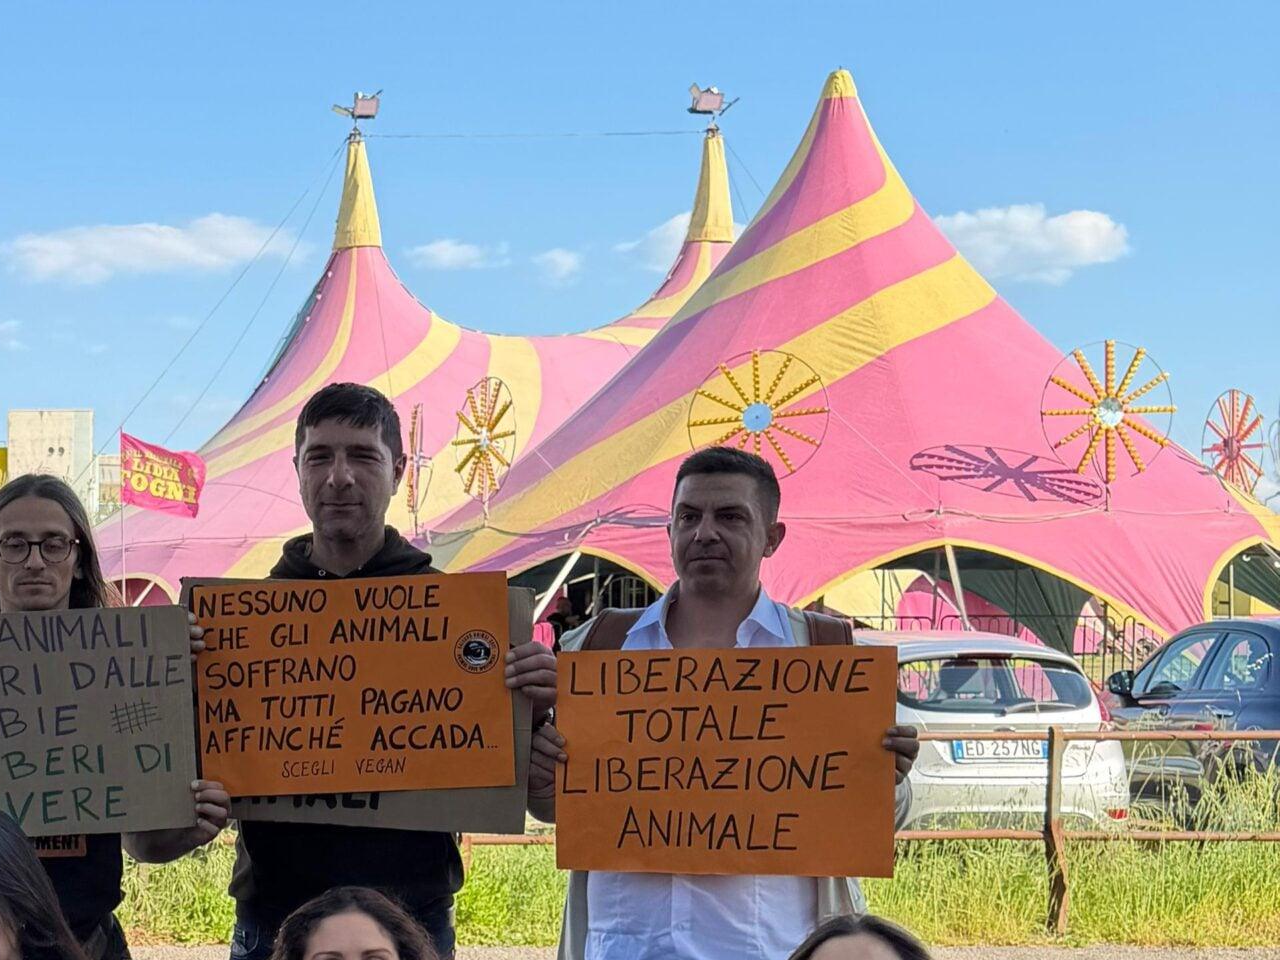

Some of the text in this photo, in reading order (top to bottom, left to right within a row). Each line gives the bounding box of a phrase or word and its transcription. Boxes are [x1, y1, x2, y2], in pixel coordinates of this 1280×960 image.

[132, 457, 181, 482] LIDIA
[198, 584, 441, 619] NESSUNO VUOLE
[202, 616, 449, 652] CHE GLI ANIMALI
[69, 654, 185, 691] DALLE
[204, 654, 357, 690] SOFFRANO
[570, 656, 874, 696] LIBERAZIONE
[205, 686, 464, 724] MA TUTTI PAGANO
[616, 703, 788, 742] TOTALE
[205, 716, 346, 754] AFFINCHÉ
[966, 741, 1041, 756] ED 257NG
[134, 743, 170, 774] DI
[281, 756, 407, 779] SCEGLI VEGAN
[562, 751, 848, 794] LIBERAZIONE
[617, 806, 799, 851] ANIMALE
